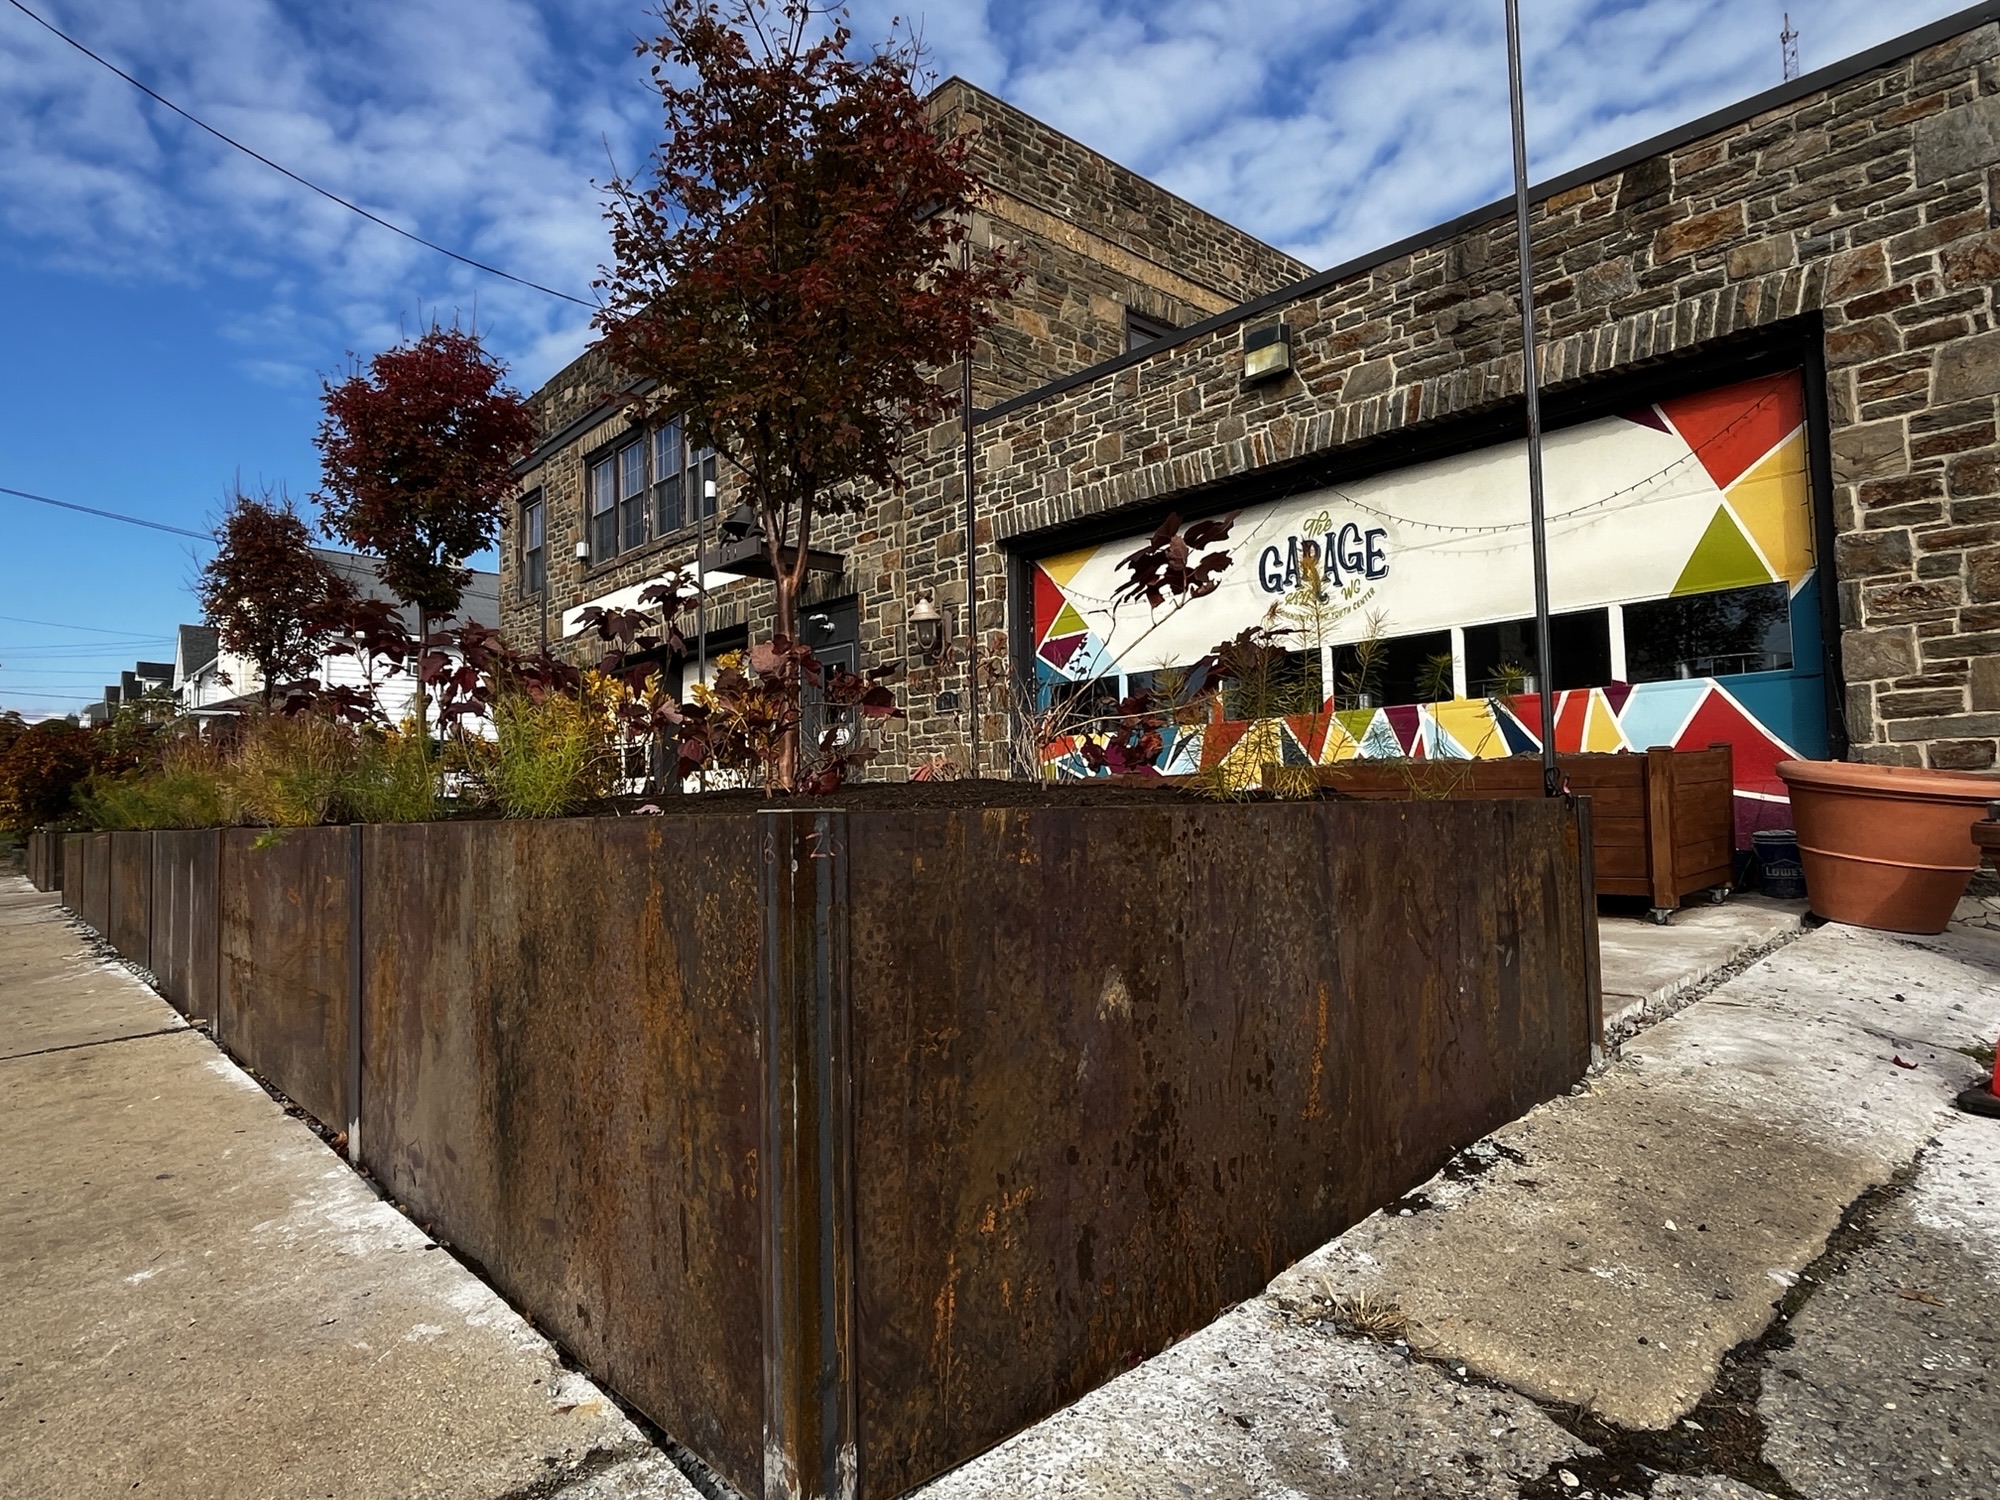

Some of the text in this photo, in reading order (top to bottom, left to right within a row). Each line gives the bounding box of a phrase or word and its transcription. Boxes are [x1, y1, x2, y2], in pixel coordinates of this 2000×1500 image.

[1303, 510, 1333, 538] The
[1258, 522, 1390, 604] GARAGE
[1340, 578, 1361, 601] WG
[1352, 587, 1376, 610] CENTER
